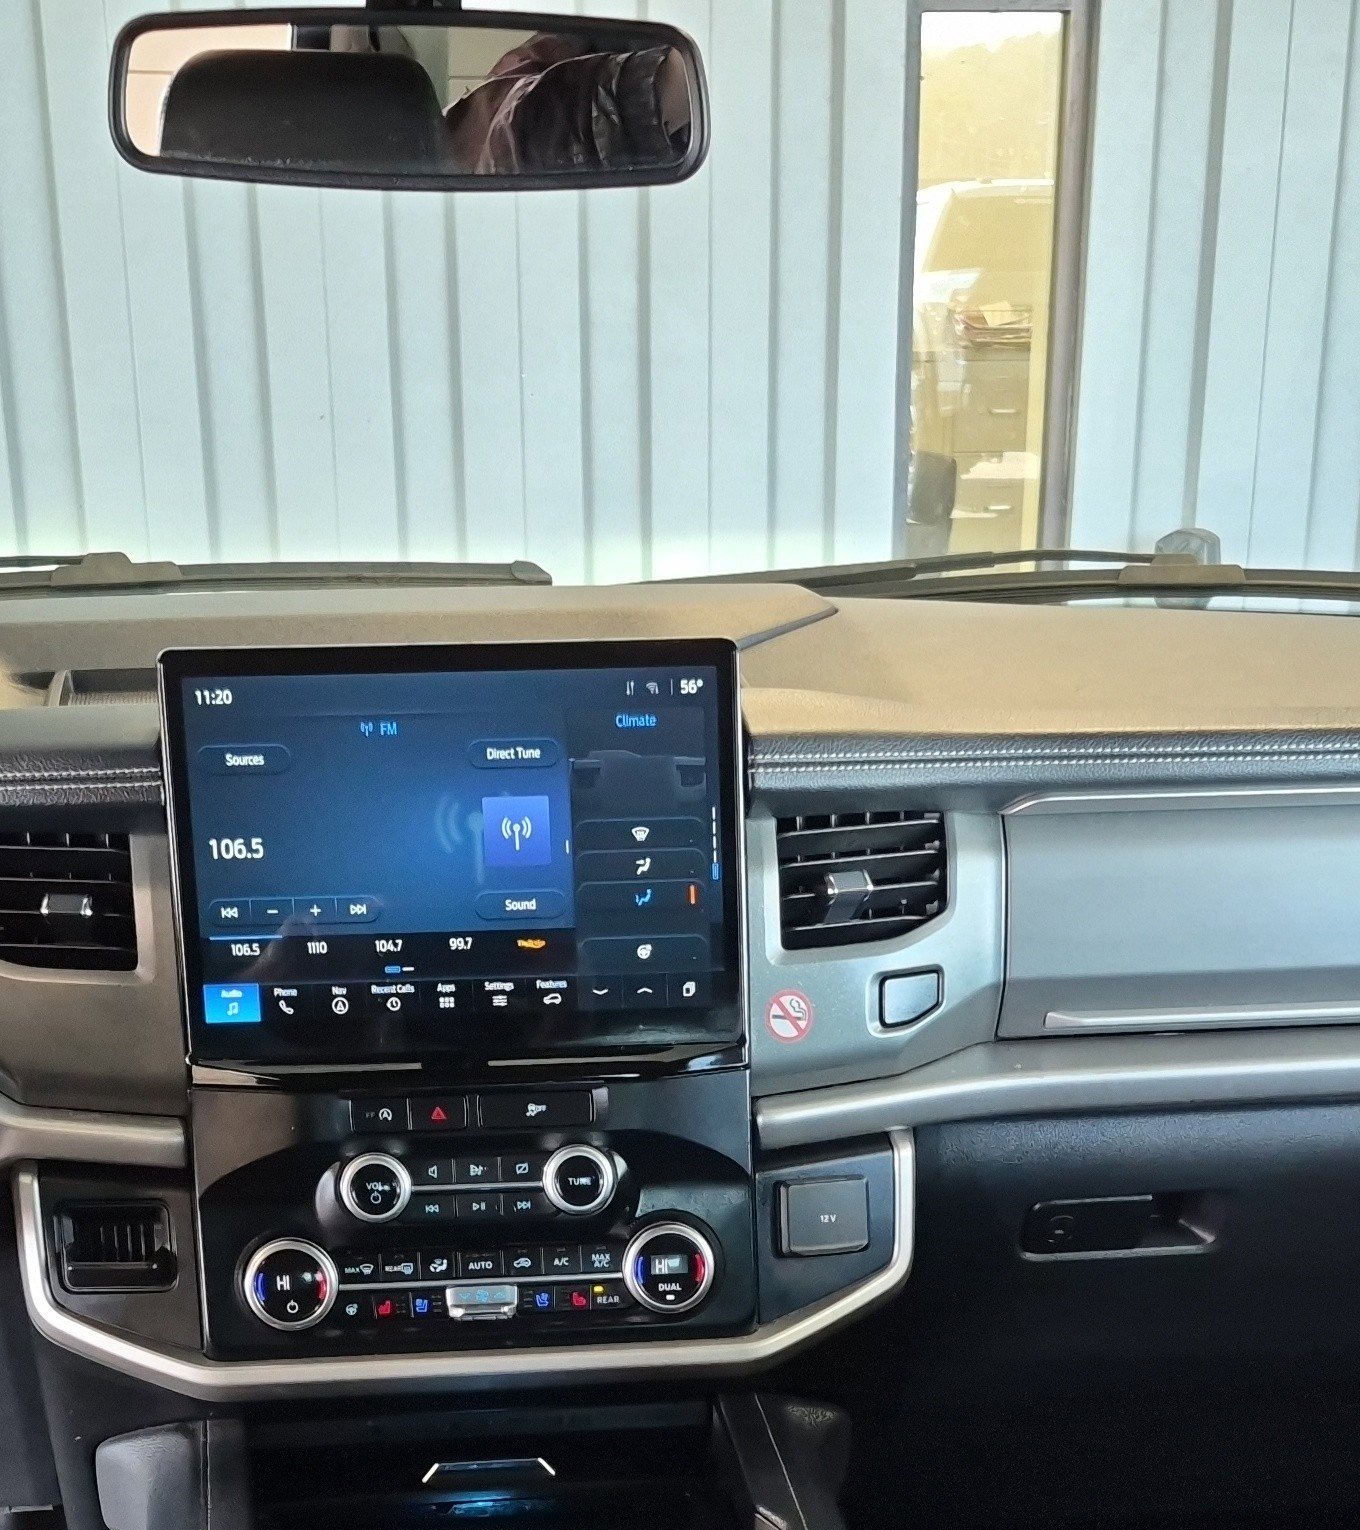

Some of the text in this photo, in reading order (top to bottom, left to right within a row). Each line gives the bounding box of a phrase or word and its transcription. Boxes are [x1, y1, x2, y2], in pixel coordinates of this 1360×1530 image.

[680, 679, 704, 695] 56°
[194, 689, 233, 705] 11:20
[615, 713, 658, 728] Climate
[379, 722, 398, 736] FM
[486, 746, 541, 760] Direct Tune
[224, 753, 265, 767] Sources
[208, 838, 264, 860] 106.5
[505, 898, 537, 911] Sound
[231, 943, 260, 956] 106.5
[307, 941, 328, 955] 1110
[374, 939, 403, 952] 104.7
[449, 937, 473, 950] 99.7
[371, 985, 396, 995] Recent
[437, 983, 456, 993] Apps
[484, 981, 514, 991] Settings
[536, 979, 568, 989] Features
[273, 988, 298, 997] Phone
[332, 986, 347, 996] Nav
[567, 1177, 592, 1186] TUNE
[553, 1256, 569, 1266] A/C
[591, 1253, 611, 1261] MAX
[468, 1261, 493, 1270] AUTO
[593, 1260, 610, 1268] A/C
[655, 1258, 668, 1274] HI
[276, 1275, 290, 1291] HI
[658, 1282, 682, 1292] DUAL
[596, 1295, 620, 1304] REAR
